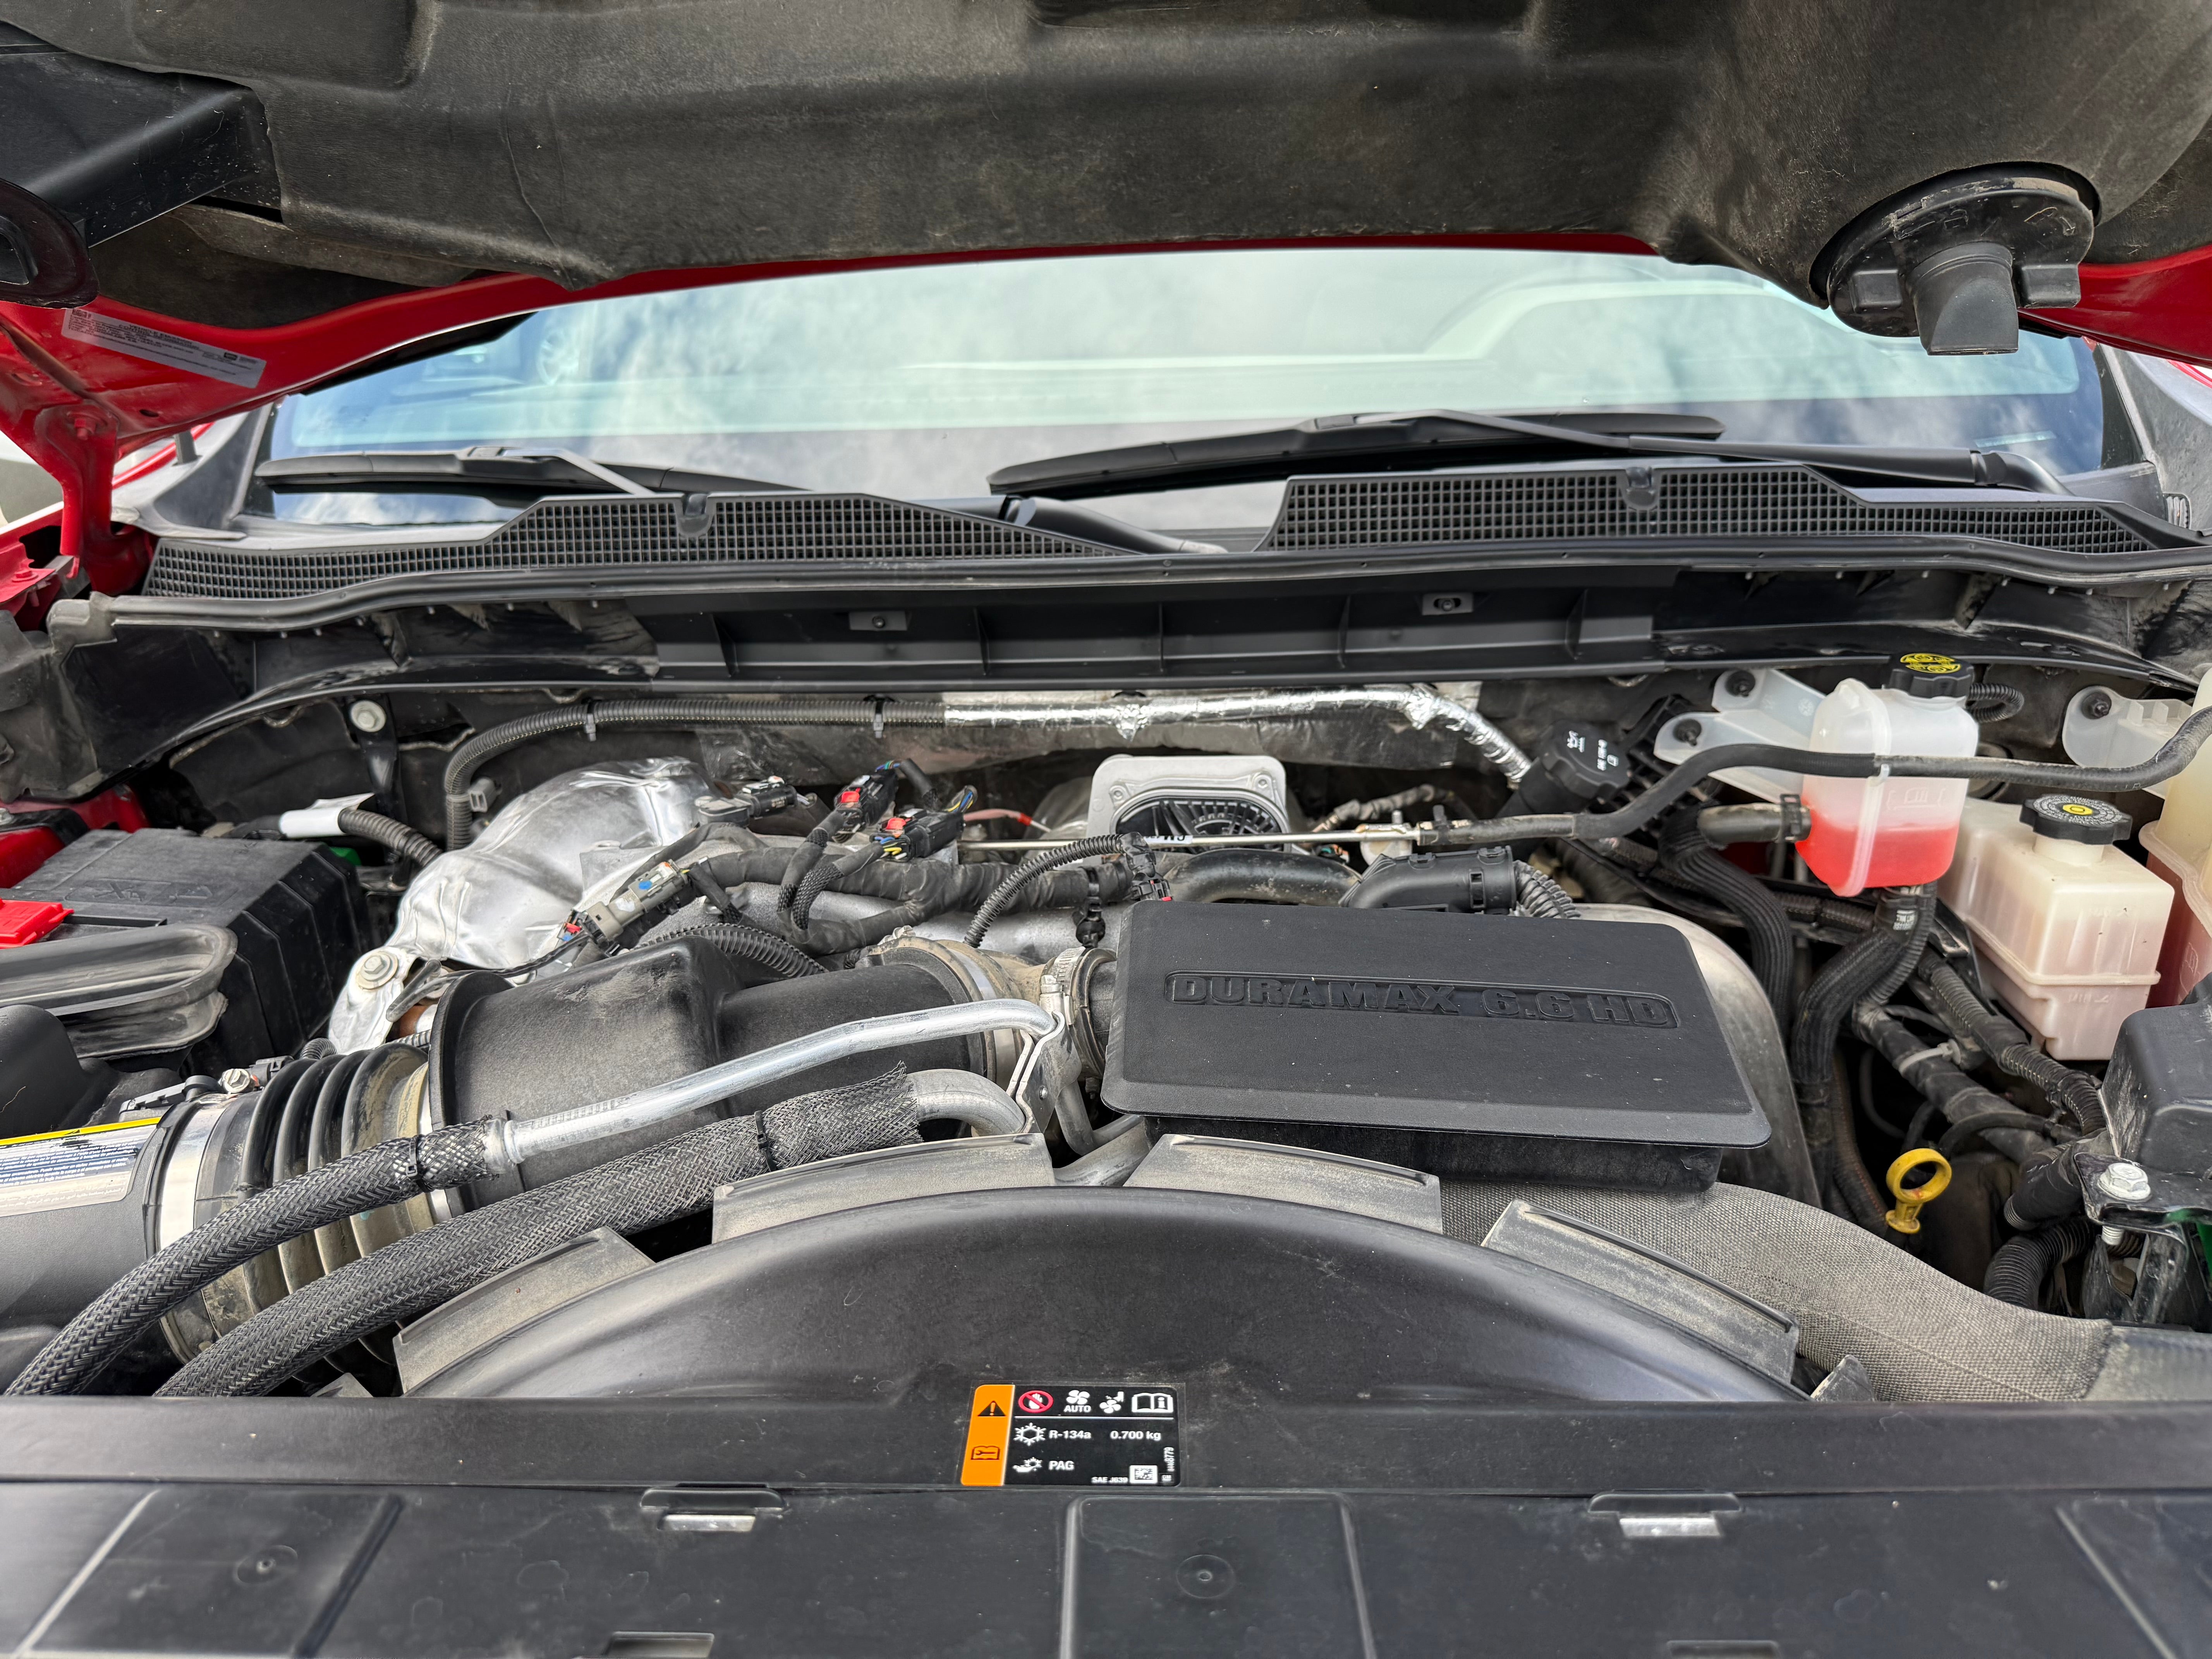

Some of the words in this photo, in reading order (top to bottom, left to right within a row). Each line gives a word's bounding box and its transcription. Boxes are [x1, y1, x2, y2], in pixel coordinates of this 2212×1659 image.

[1173, 977, 1459, 1014] DURAMAX
[1482, 988, 1575, 1019] 6.6
[1587, 994, 1668, 1025] HD
[1049, 1431, 1091, 1439] R-134a
[1110, 1431, 1143, 1439] 0.700
[1146, 1431, 1161, 1441] kg
[1049, 1461, 1074, 1470] PAG
